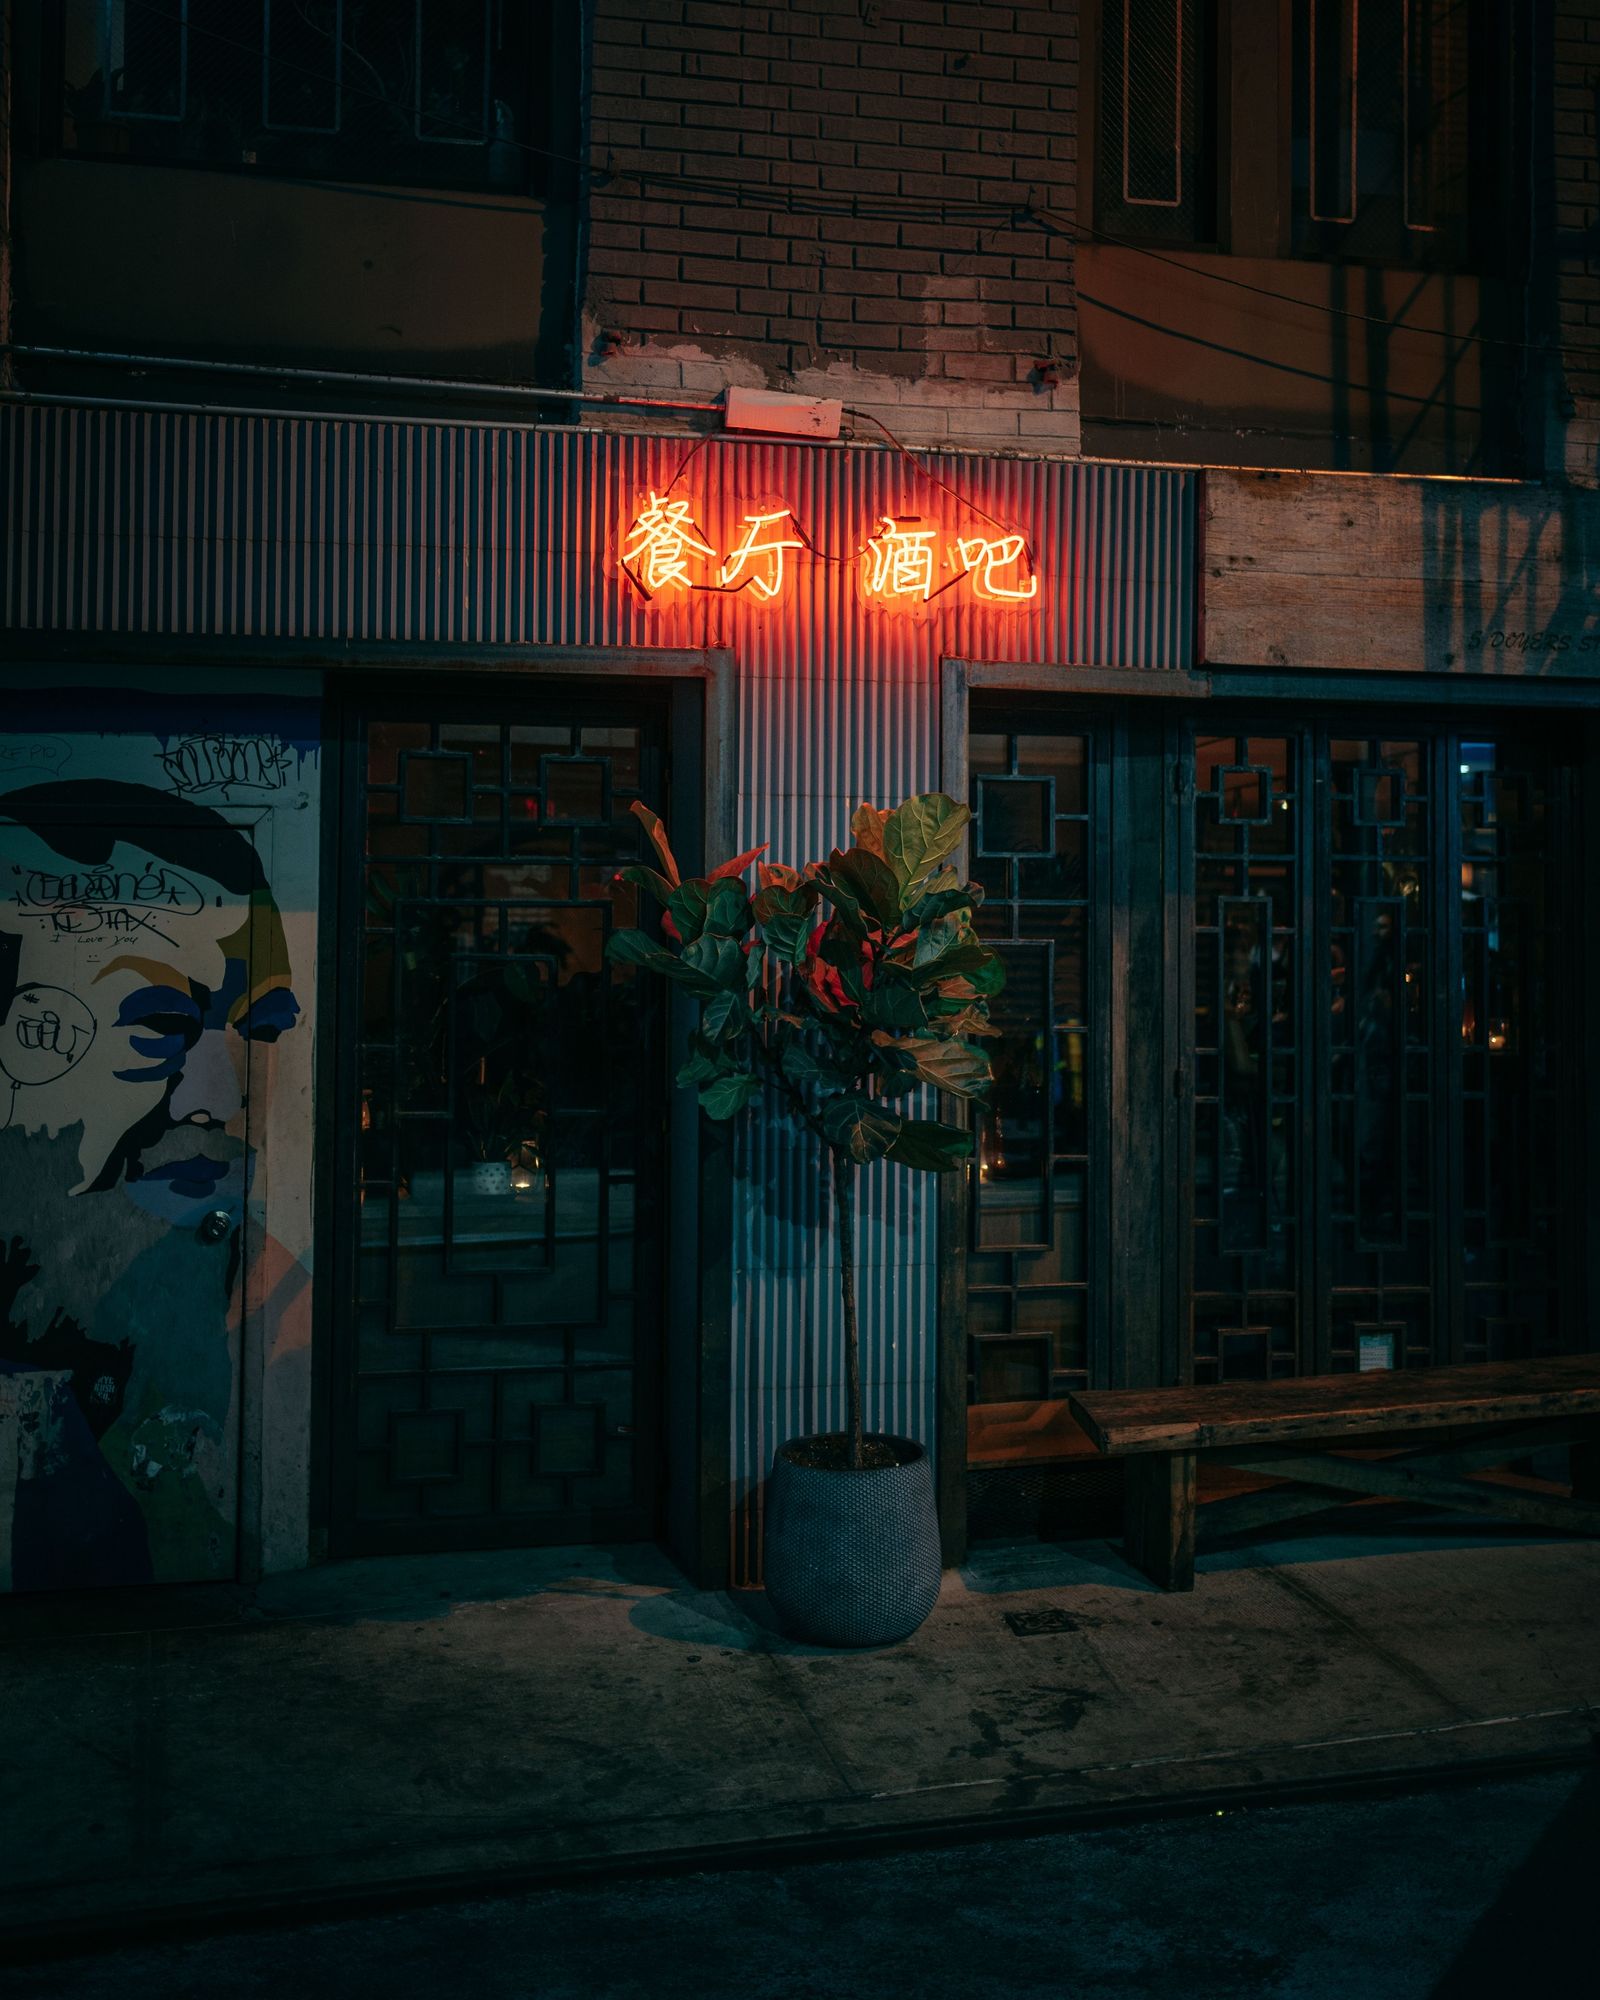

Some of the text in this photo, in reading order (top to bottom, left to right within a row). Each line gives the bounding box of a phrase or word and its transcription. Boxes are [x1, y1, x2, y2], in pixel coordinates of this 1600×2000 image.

[620, 491, 1038, 600] 餐厅 酒吧
[1490, 630, 1572, 654] DOYERS
